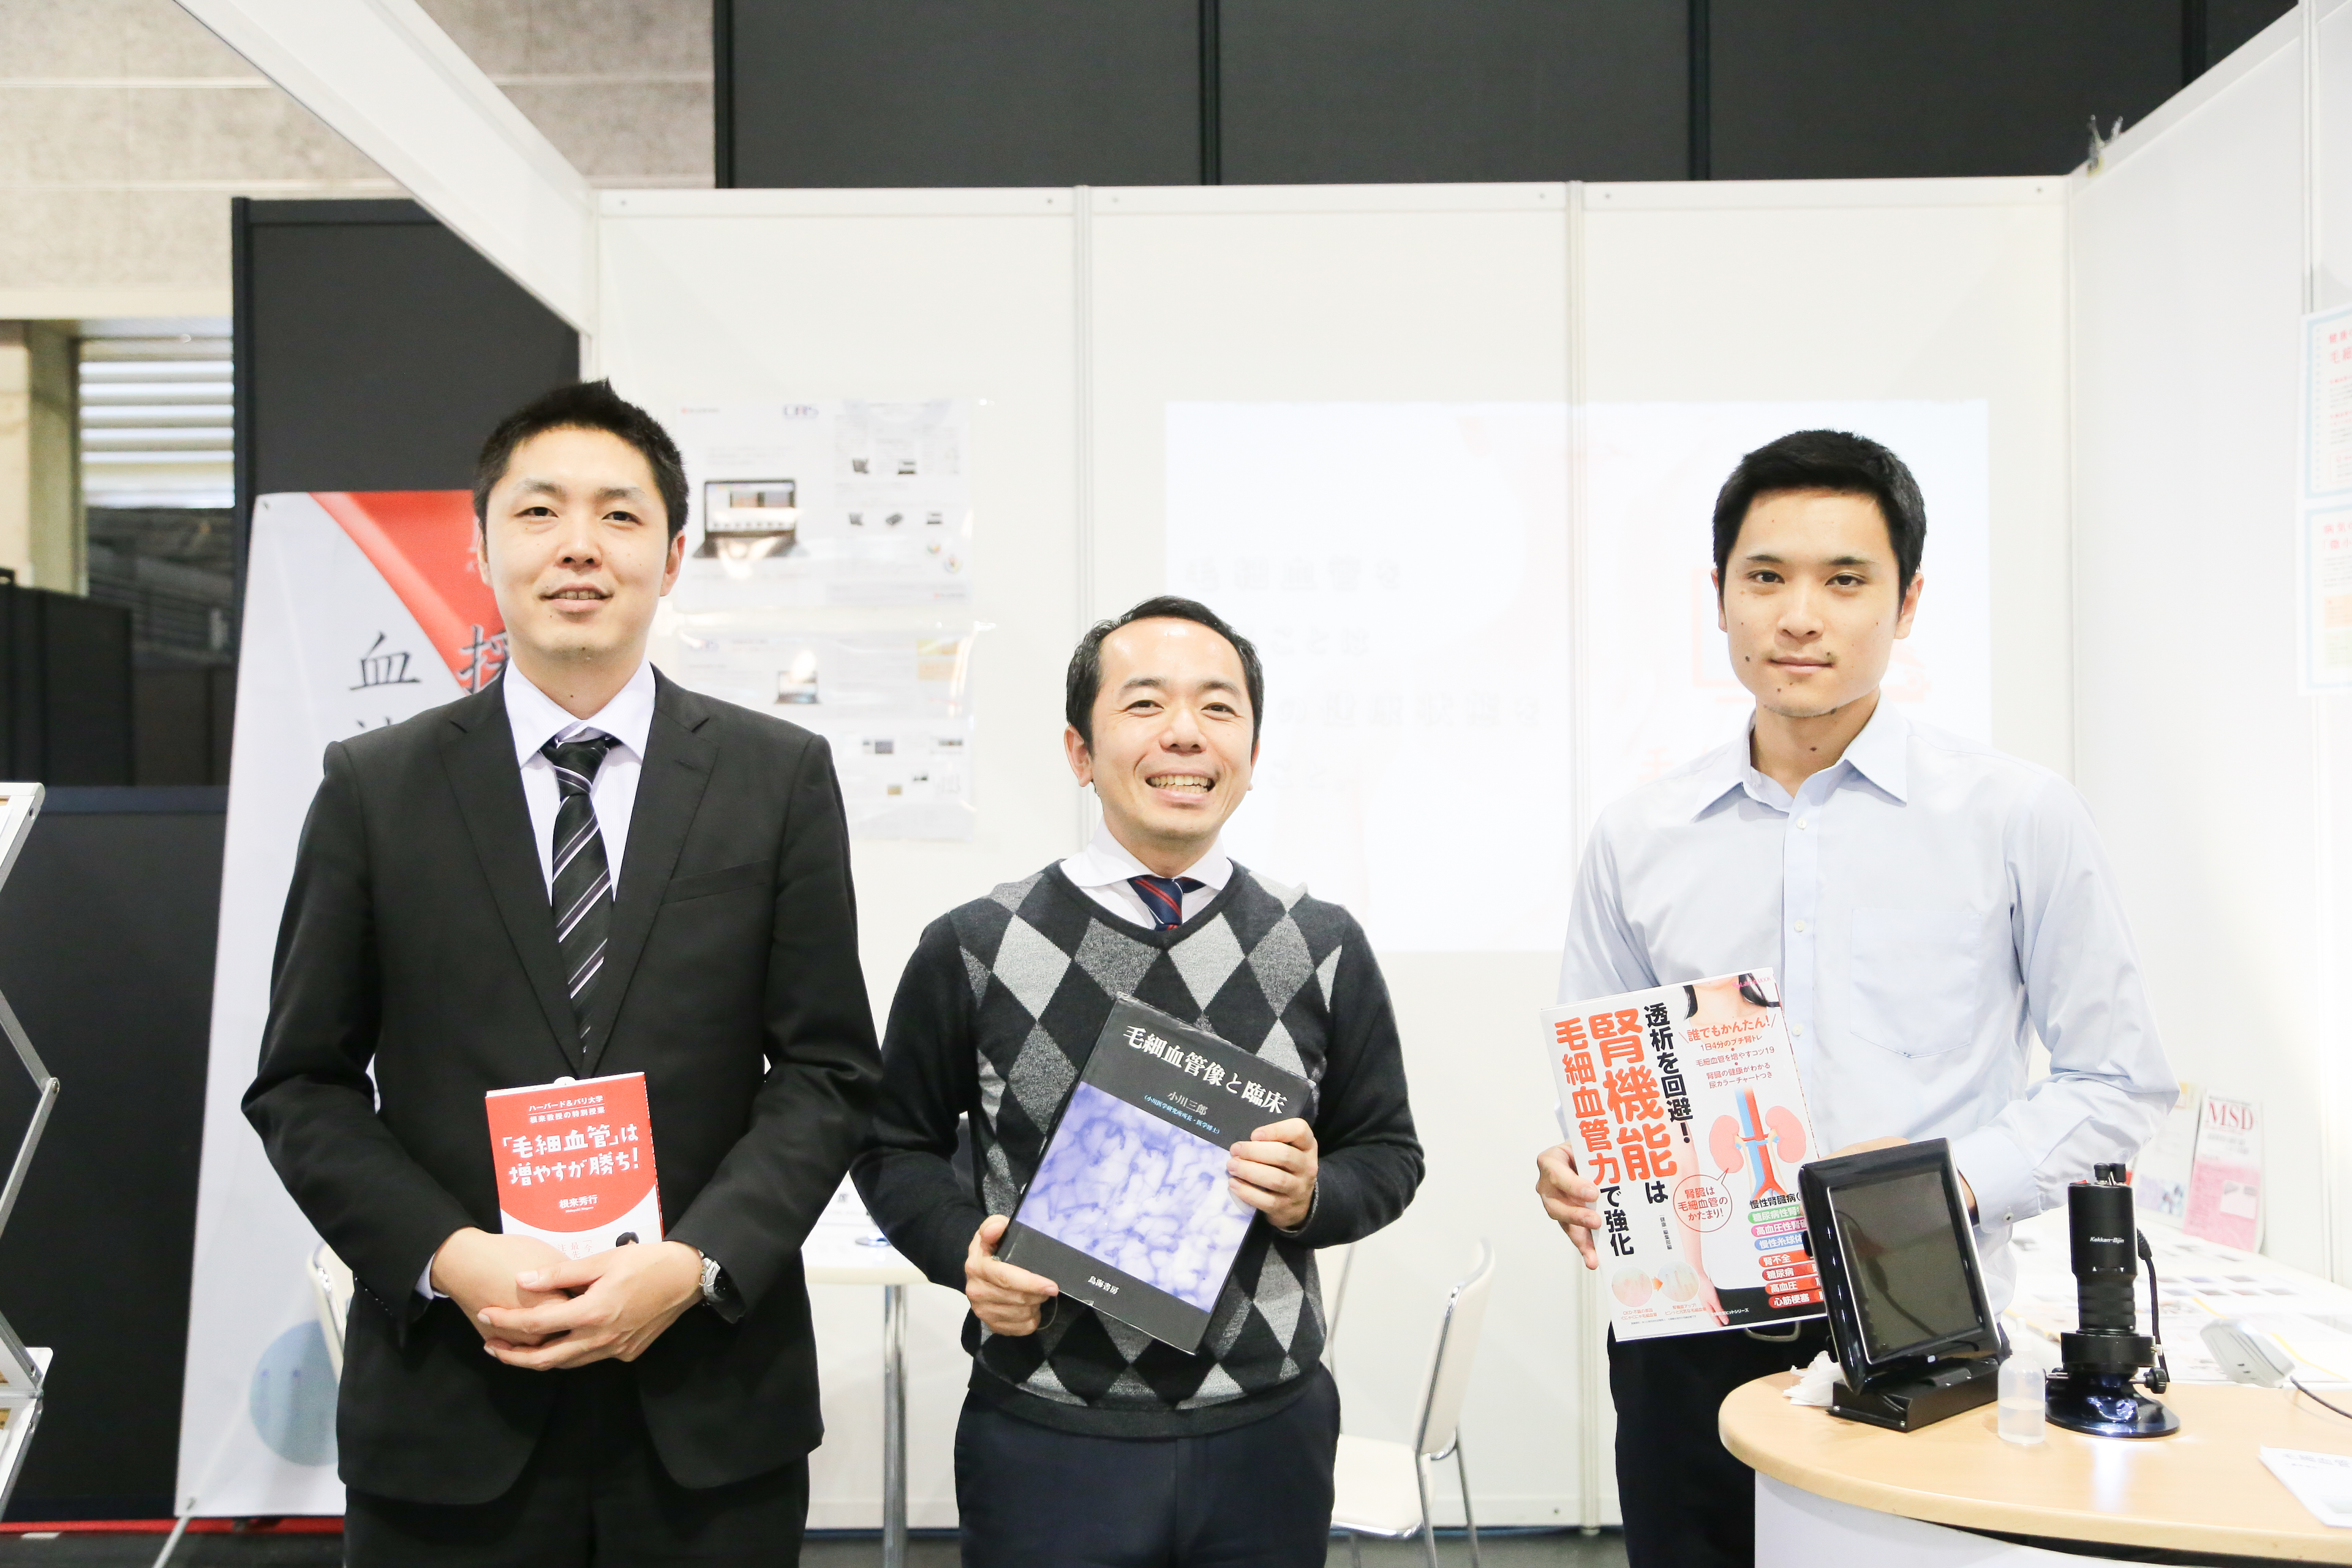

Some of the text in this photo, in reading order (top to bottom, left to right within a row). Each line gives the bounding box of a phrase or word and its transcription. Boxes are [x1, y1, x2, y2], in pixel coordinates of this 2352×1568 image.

[1696, 1046, 1774, 1067] 毛細血管を増やすコツ19
[1123, 1025, 1287, 1114] 毛細血管像と臨床
[1706, 1063, 1770, 1080] 腎臓の健康がわかる
[1709, 1071, 1773, 1088] 尿カラーチャートつき
[1167, 1091, 1208, 1115] 小川三郎
[1589, 1008, 1677, 1204] 腎機能は
[530, 1106, 605, 1123] 根来教授の特別授業
[2206, 1101, 2253, 1130] MSD
[503, 1123, 639, 1158] 「毛細血管」は
[1555, 1017, 1634, 1256] 毛細血管力で強化
[1685, 1186, 1715, 1199] 腎臓は
[559, 1194, 598, 1209] 根来秀行
[1678, 1197, 1727, 1212] 毛細血管の
[1763, 1254, 1791, 1266] 腎不全
[1766, 1267, 1794, 1279] 糖尿病
[1770, 1281, 1798, 1293] 高血圧
[1774, 1293, 1810, 1306] 心筋梗塞
